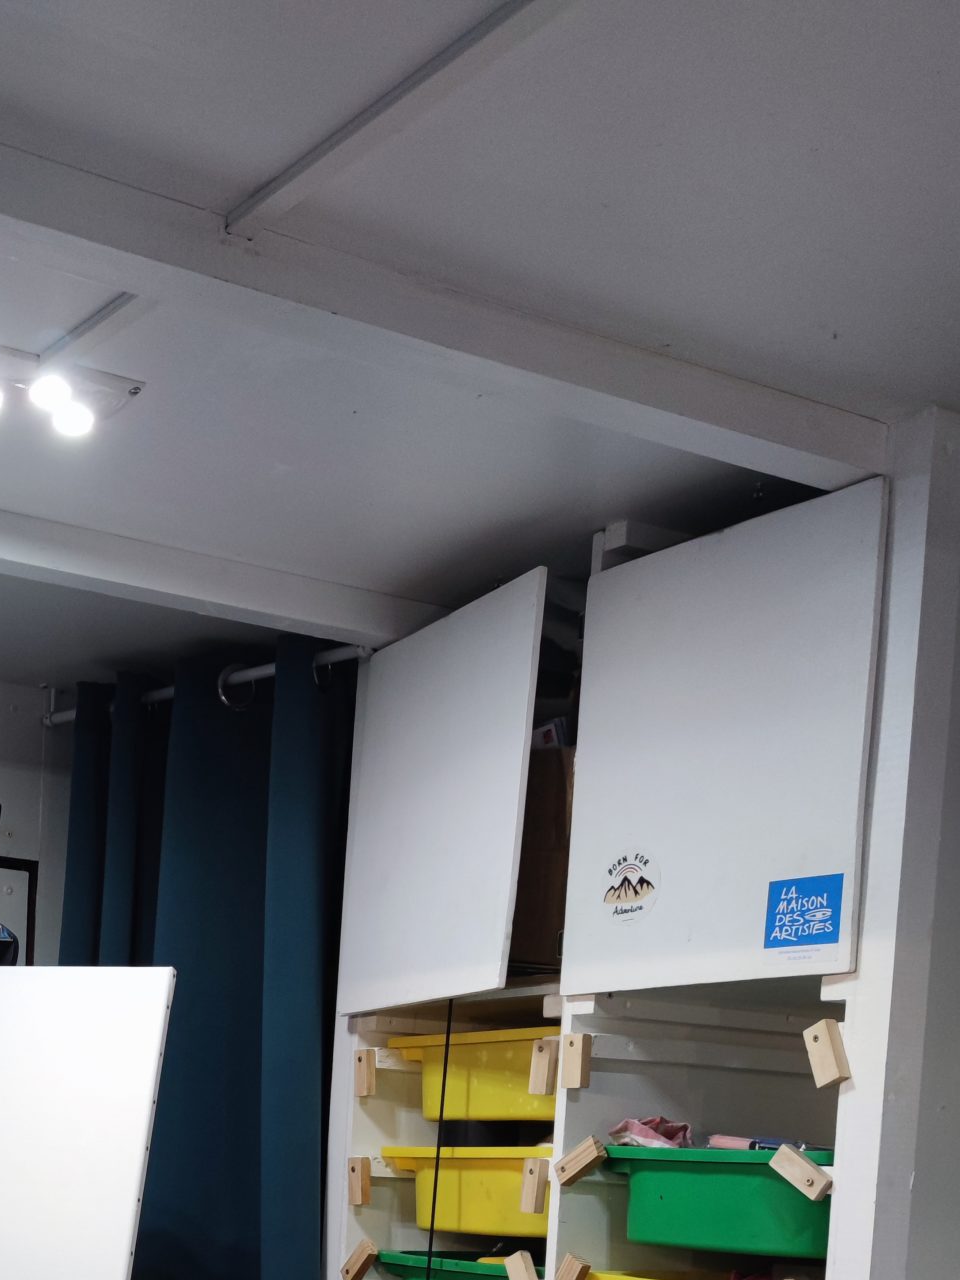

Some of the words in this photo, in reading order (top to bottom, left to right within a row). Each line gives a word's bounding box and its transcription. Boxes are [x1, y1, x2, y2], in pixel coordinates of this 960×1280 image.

[607, 855, 628, 876] BORN
[634, 853, 650, 867] FOR
[780, 886, 798, 900] LA
[613, 905, 644, 917] Adventure
[775, 911, 804, 926] DES
[769, 920, 833, 941] ARTISTES
